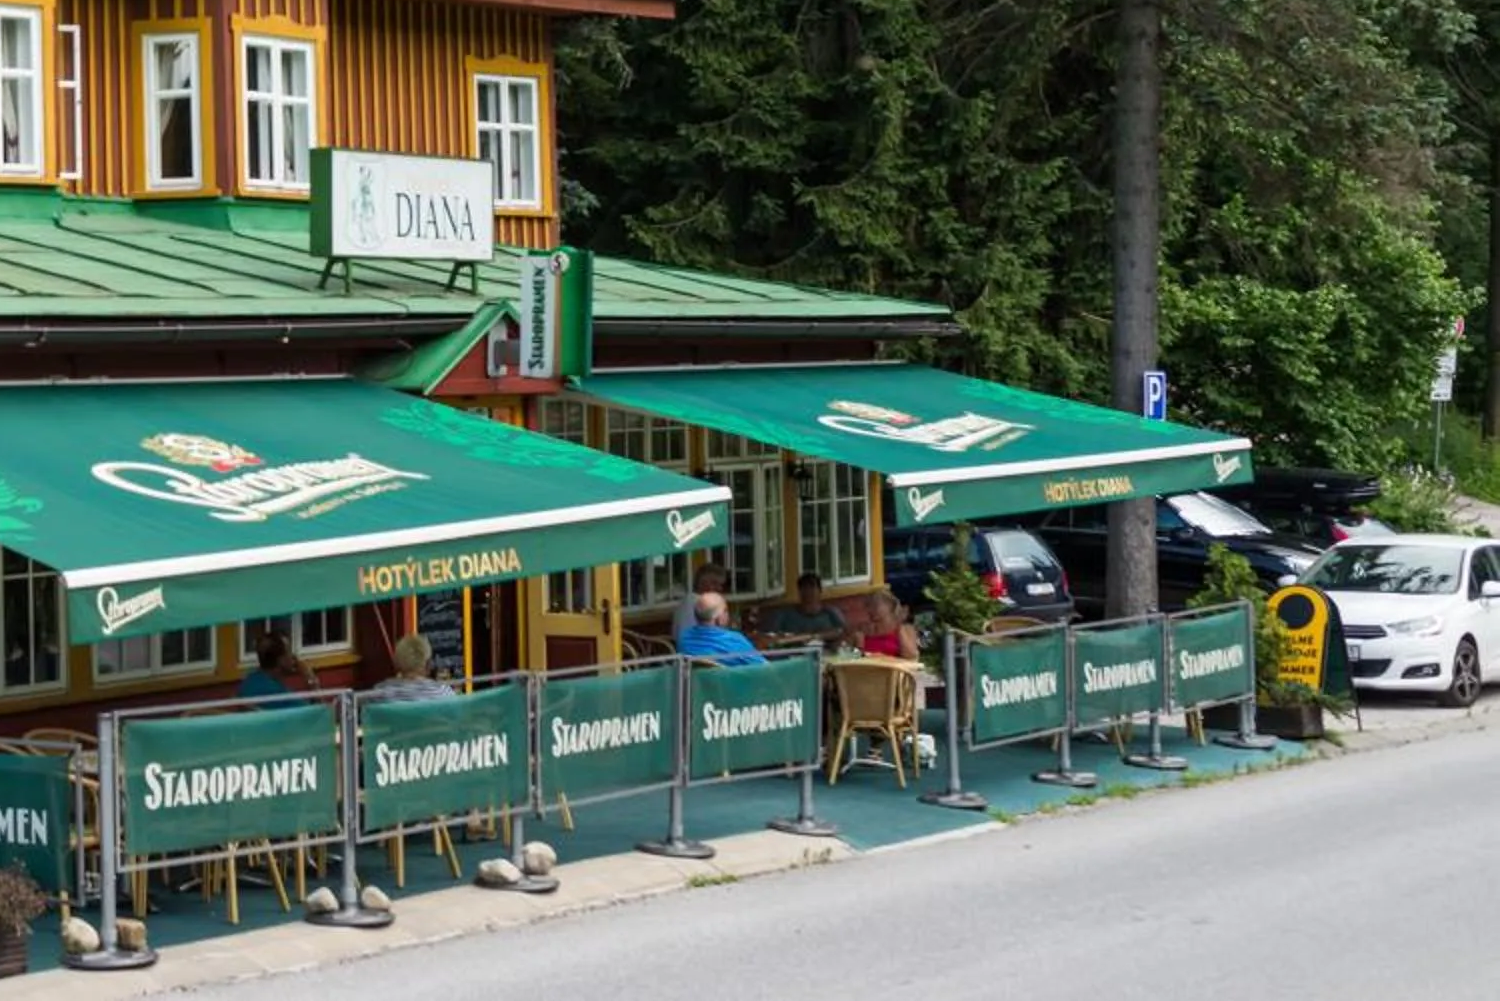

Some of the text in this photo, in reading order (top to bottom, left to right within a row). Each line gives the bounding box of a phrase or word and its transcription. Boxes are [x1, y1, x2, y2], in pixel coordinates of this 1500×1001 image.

[395, 192, 476, 242] DIANA
[1149, 376, 1161, 416] P
[358, 548, 522, 595] HOTÝLEK DIANA
[1083, 659, 1157, 693] STAROPRAMEN
[1180, 644, 1245, 680] STAROPRAMEN
[981, 671, 1057, 709] STAROPRAMEN
[551, 711, 660, 758] STAROPRAMEN
[702, 698, 803, 742] STAROPRAMEN
[376, 733, 508, 786] STAROPRAMEN
[145, 756, 318, 811] STAROPRAMEN
